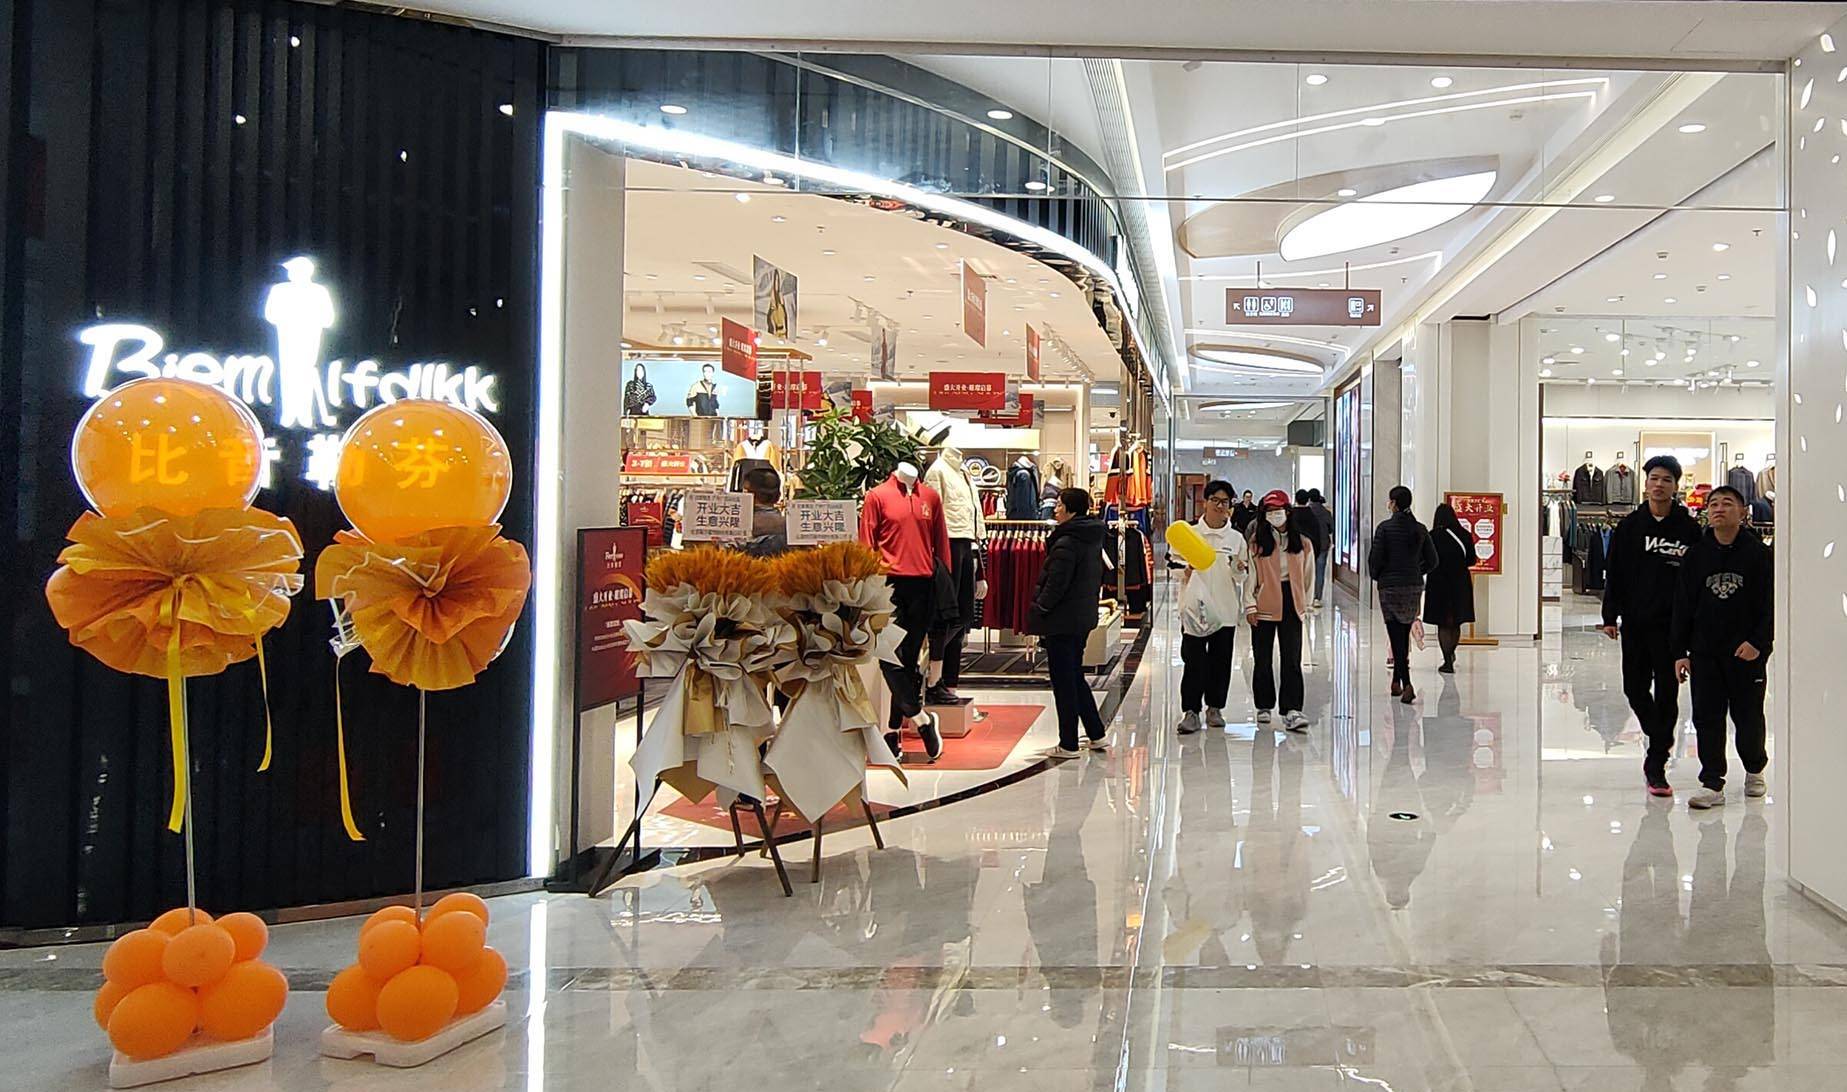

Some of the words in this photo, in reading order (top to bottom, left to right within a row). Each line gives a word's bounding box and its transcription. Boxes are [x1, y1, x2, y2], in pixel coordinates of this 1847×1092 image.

[697, 502, 742, 515] 开业大吉
[696, 515, 740, 528] 生意兴隆
[800, 510, 845, 521] 开业大吉
[800, 522, 846, 533] 生意兴隆
